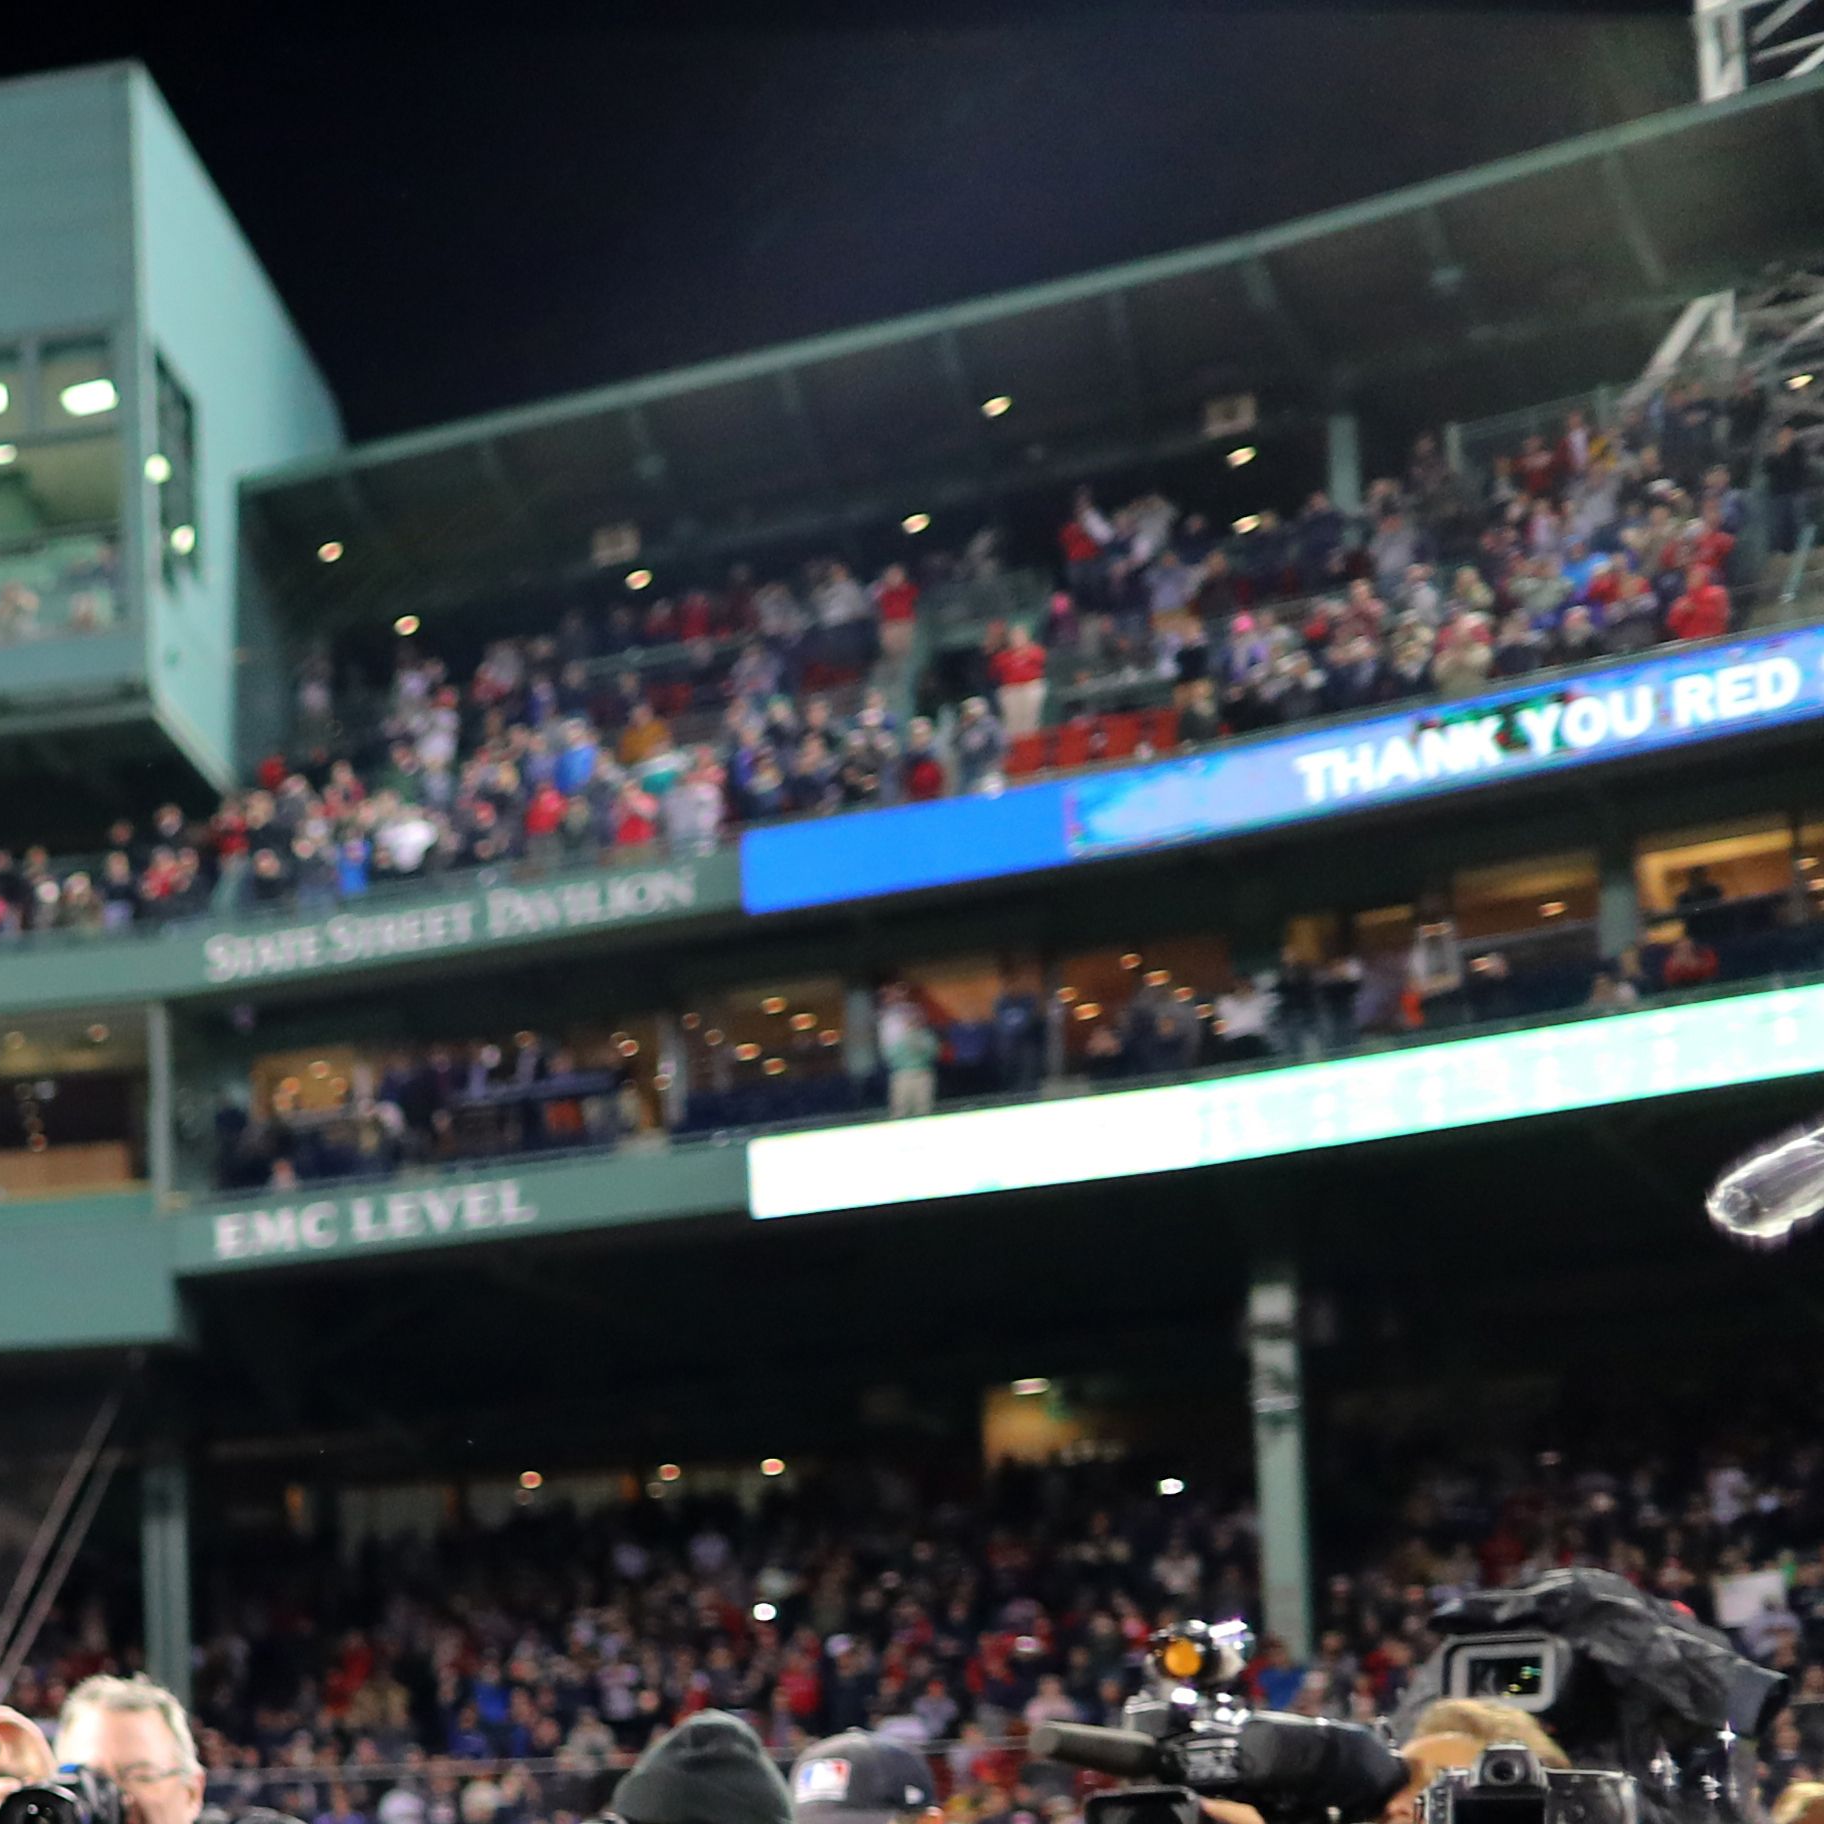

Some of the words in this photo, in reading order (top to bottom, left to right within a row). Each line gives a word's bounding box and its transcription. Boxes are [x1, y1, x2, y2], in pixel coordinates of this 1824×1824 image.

[1295, 717, 1503, 802] THANK
[1520, 690, 1653, 756] YOU
[1673, 658, 1801, 726] RED
[214, 1200, 339, 1260] EMC
[351, 1178, 539, 1243] LEVEL
